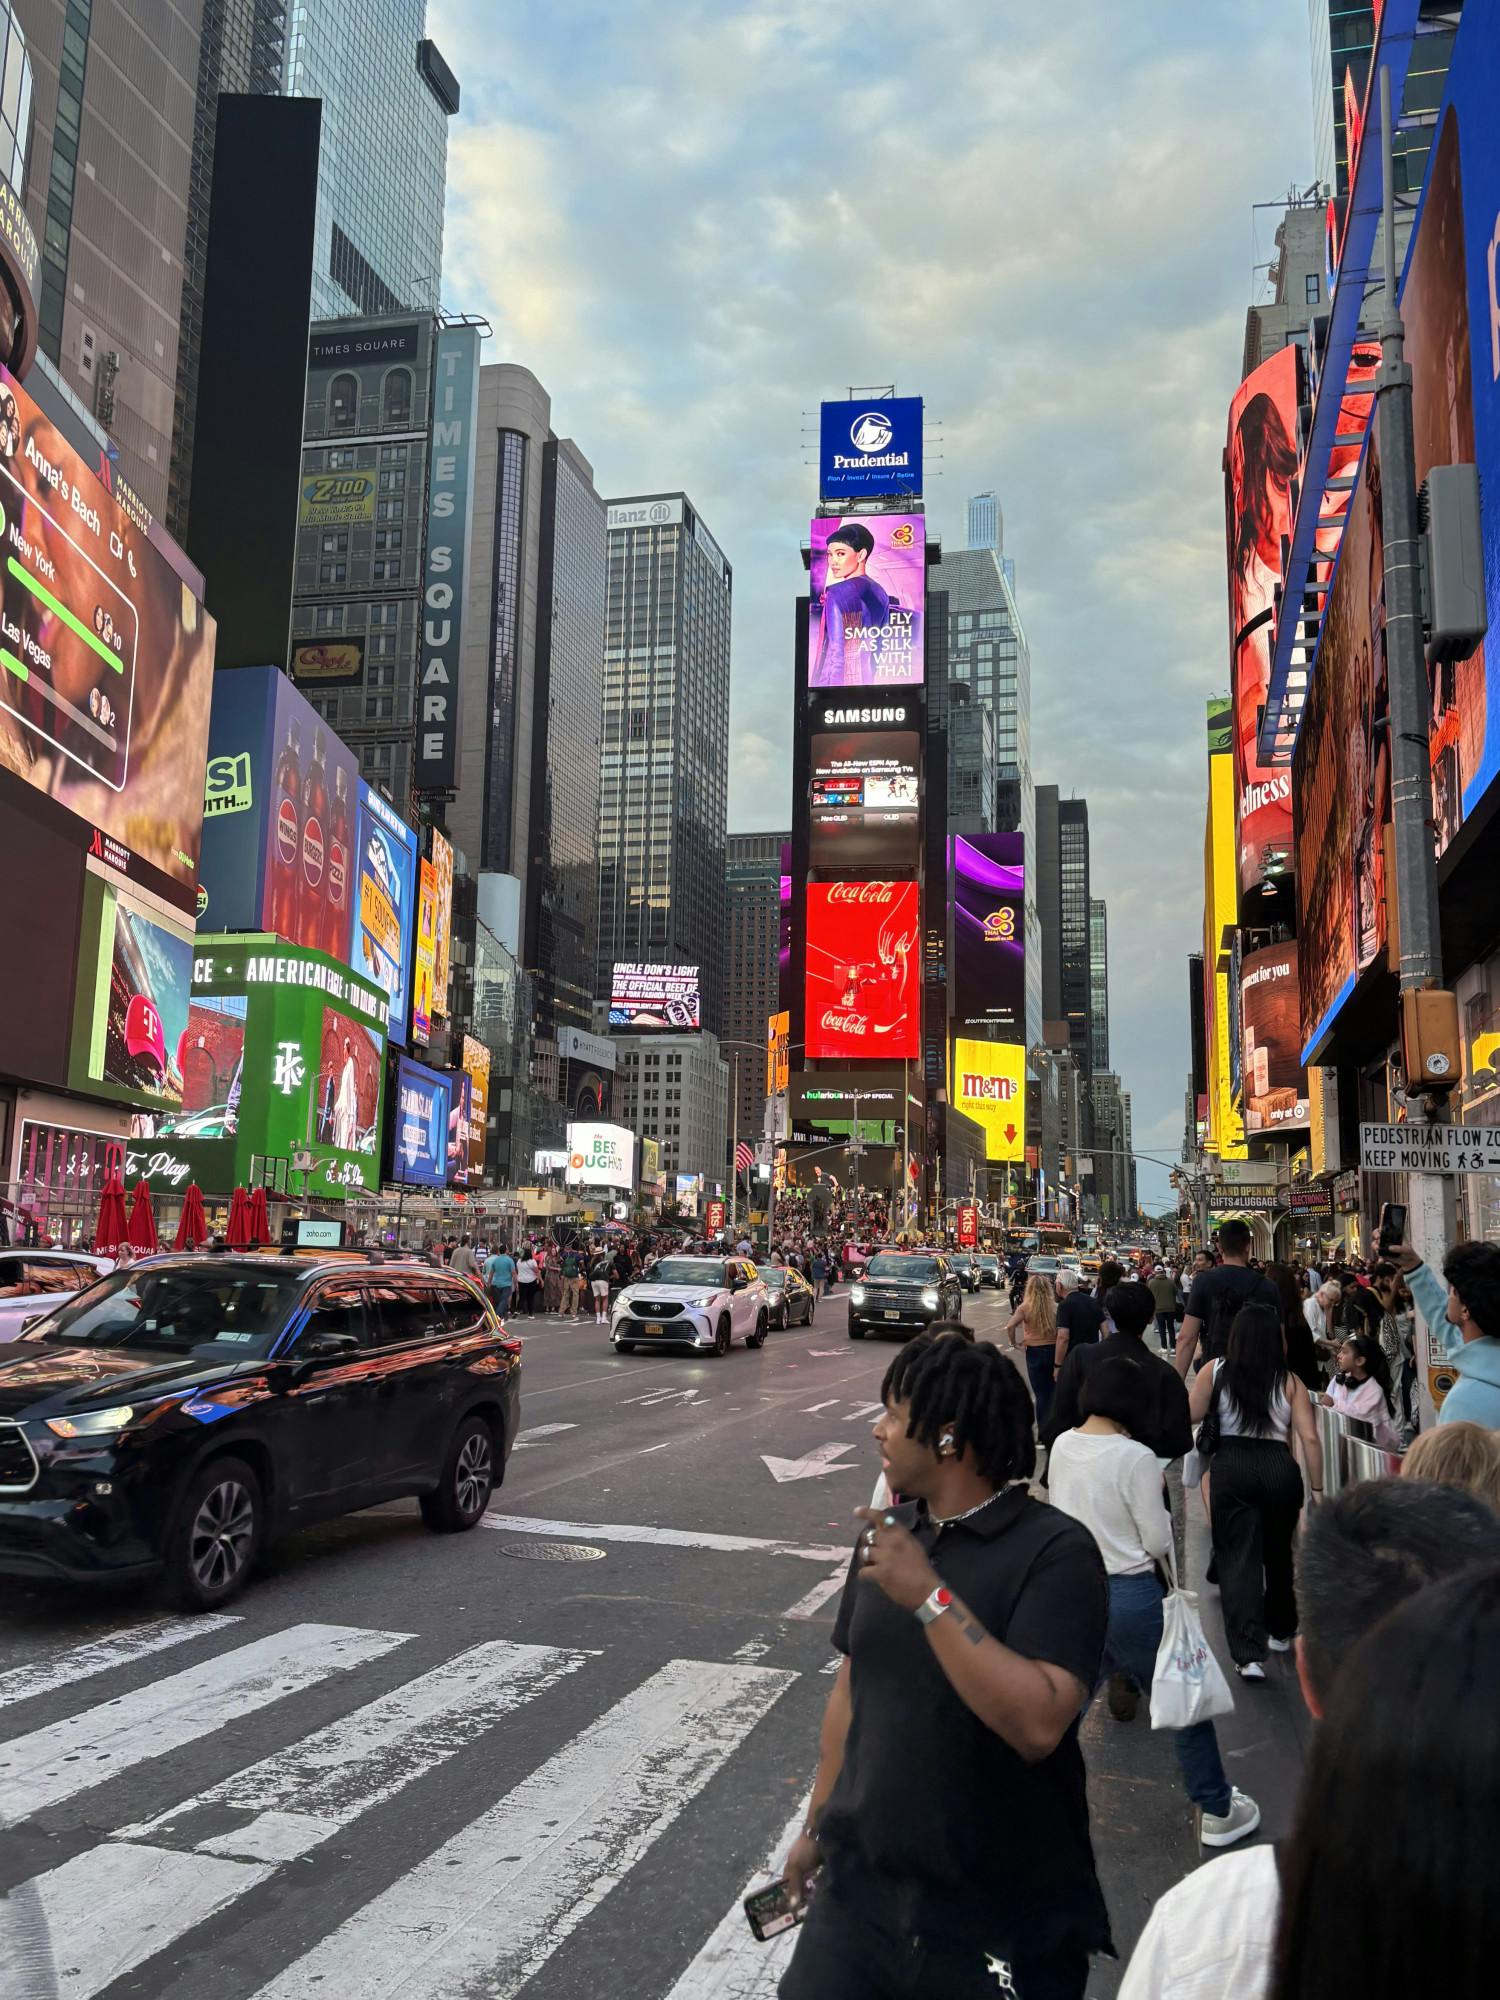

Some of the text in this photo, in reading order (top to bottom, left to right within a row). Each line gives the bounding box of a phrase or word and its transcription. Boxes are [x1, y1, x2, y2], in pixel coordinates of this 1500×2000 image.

[313, 338, 406, 356] TIMES SQUARE
[432, 350, 462, 518] TIMES
[833, 452, 909, 469] Prudential
[25, 436, 101, 537] Anna's Bach
[311, 479, 368, 503] Z100
[116, 474, 153, 525] MARRIOTT
[115, 492, 148, 536] MARQUIS
[10, 522, 56, 583] New York
[889, 612, 913, 625] FLY
[1, 611, 51, 670] Las Vegas
[112, 632, 122, 651] 10
[844, 625, 913, 640] SMOOTH
[422, 546, 453, 760] SQUARE
[858, 638, 913, 652] AS SILK
[872, 651, 912, 664] WITH
[876, 664, 912, 677] THAI
[109, 713, 115, 727] 2
[824, 707, 906, 724] SAMSUNG
[885, 760, 899, 768] App
[279, 819, 297, 844] WINGS
[104, 838, 131, 860] MARRIOTT
[304, 836, 323, 867] BURGERS
[330, 864, 344, 883] PIZZA
[827, 881, 896, 904] Coca-Cola
[190, 958, 214, 983] CE
[246, 957, 326, 990] AMERICAN
[327, 969, 344, 1000] EAGLE
[612, 962, 699, 977] UNCLE DON'S LIGHT
[1272, 963, 1290, 982] you
[612, 980, 627, 990] THE
[628, 981, 663, 991] OFFICIAL
[664, 982, 686, 992] BEER
[641, 991, 666, 999] FASHION
[821, 1010, 870, 1035] Coca-Cola
[1364, 1127, 1443, 1146] PEDESTRIAN
[1447, 1129, 1481, 1147] FLOW
[141, 1151, 191, 1186] Play
[1364, 1150, 1450, 1168] KEEP MOVING
[1240, 1186, 1277, 1197] OPENING
[1210, 1197, 1234, 1207] GIFTS
[1240, 1197, 1278, 1207] LUGGAGE
[710, 1202, 723, 1228] tkts
[962, 1208, 975, 1233] tkts
[306, 1230, 332, 1238] zoho.com
